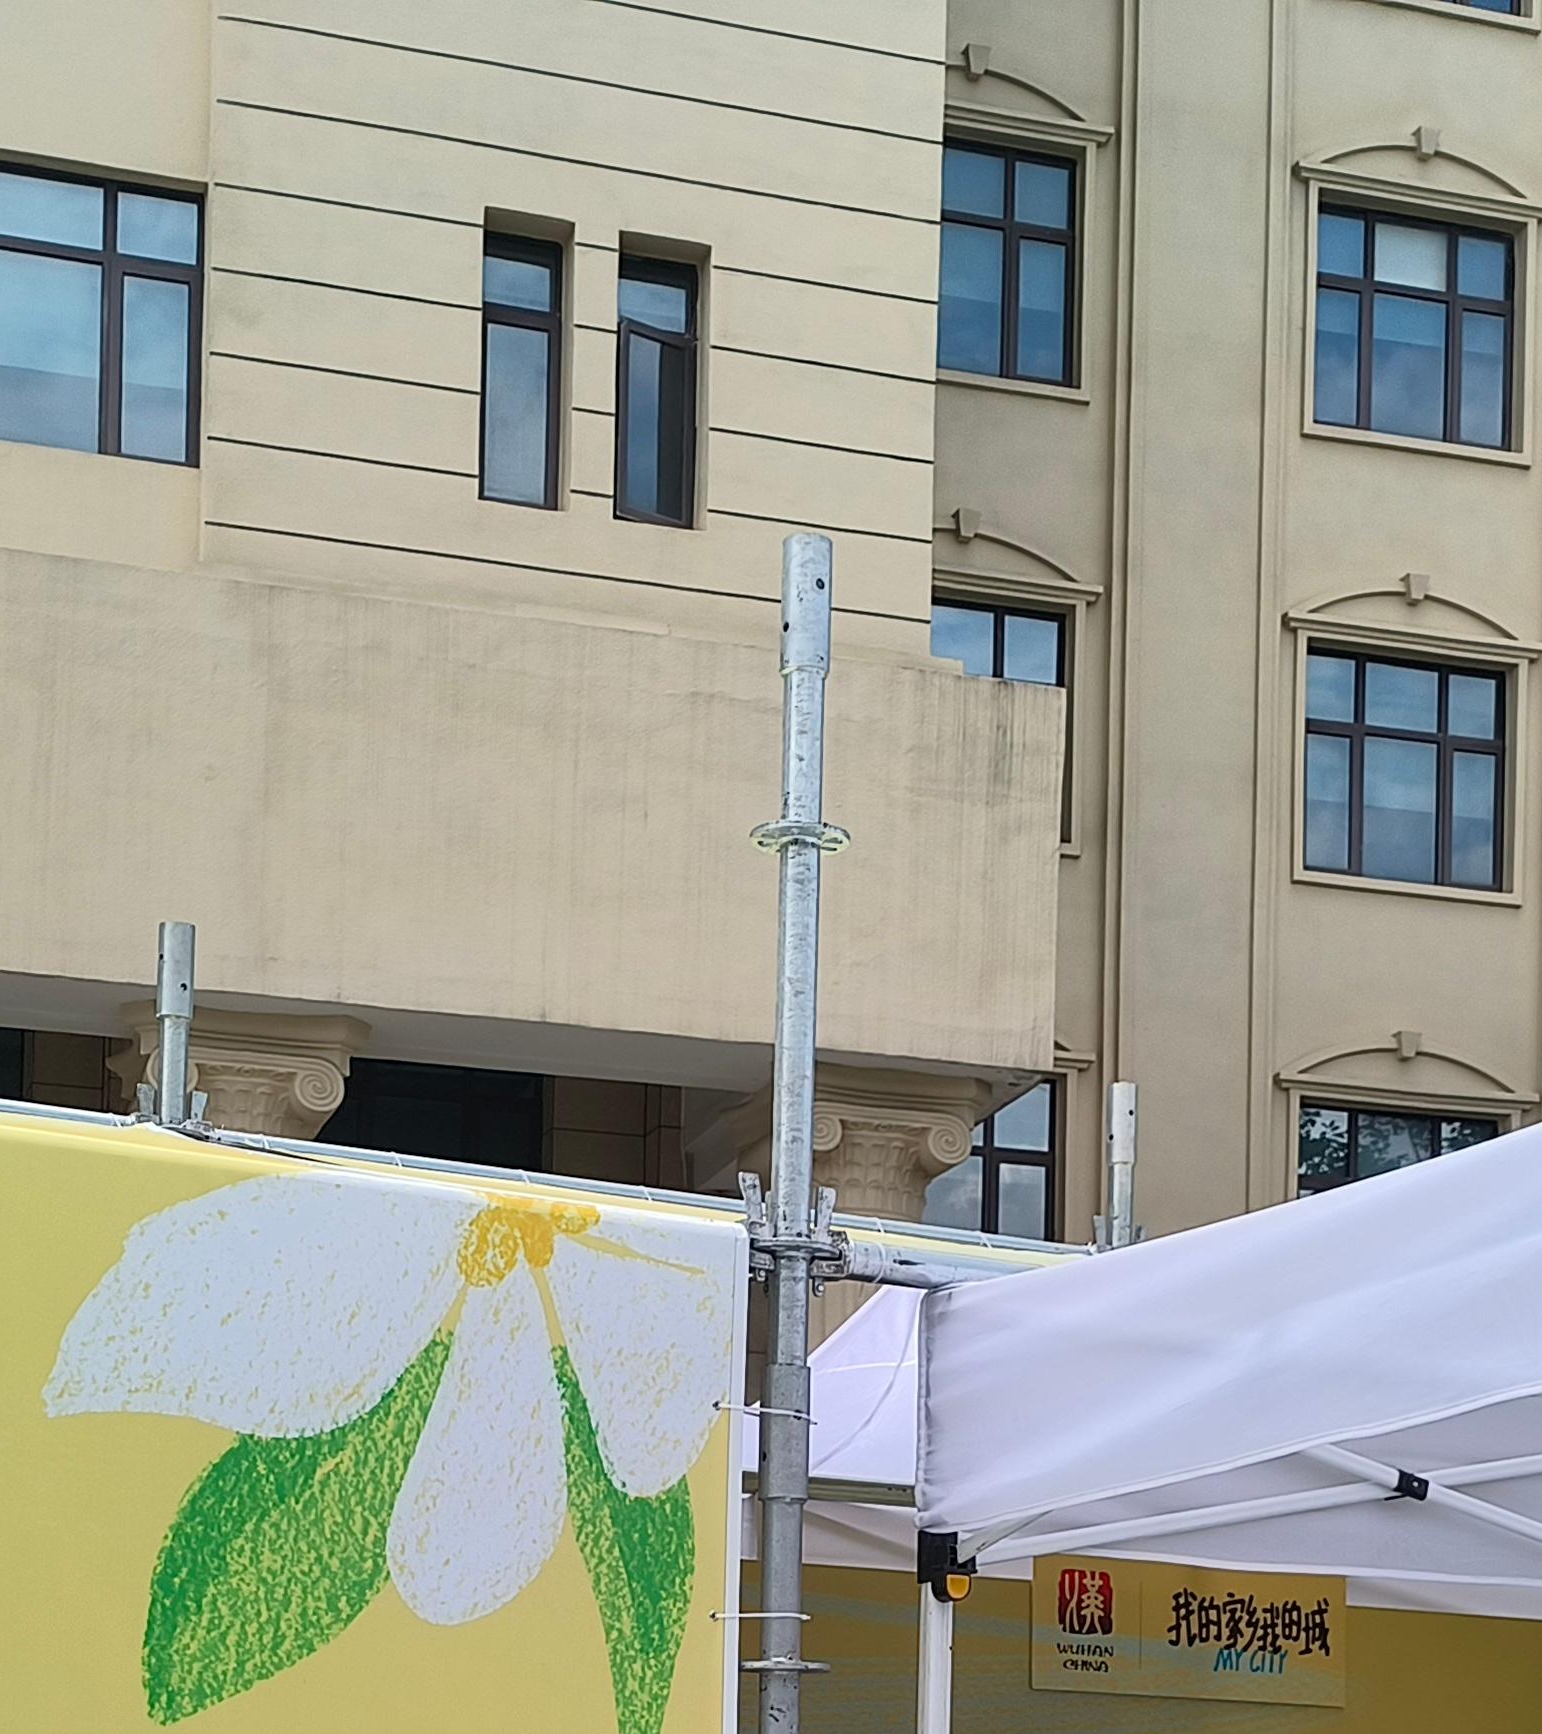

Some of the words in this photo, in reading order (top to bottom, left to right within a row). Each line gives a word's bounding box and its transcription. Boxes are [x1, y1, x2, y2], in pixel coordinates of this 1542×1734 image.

[1167, 1588, 1330, 1656] 我的家乡我的城
[1058, 1643, 1114, 1657] WUHAN
[1062, 1659, 1109, 1672] CHINA
[1214, 1648, 1244, 1672] MY
[1249, 1650, 1288, 1674] CITY
